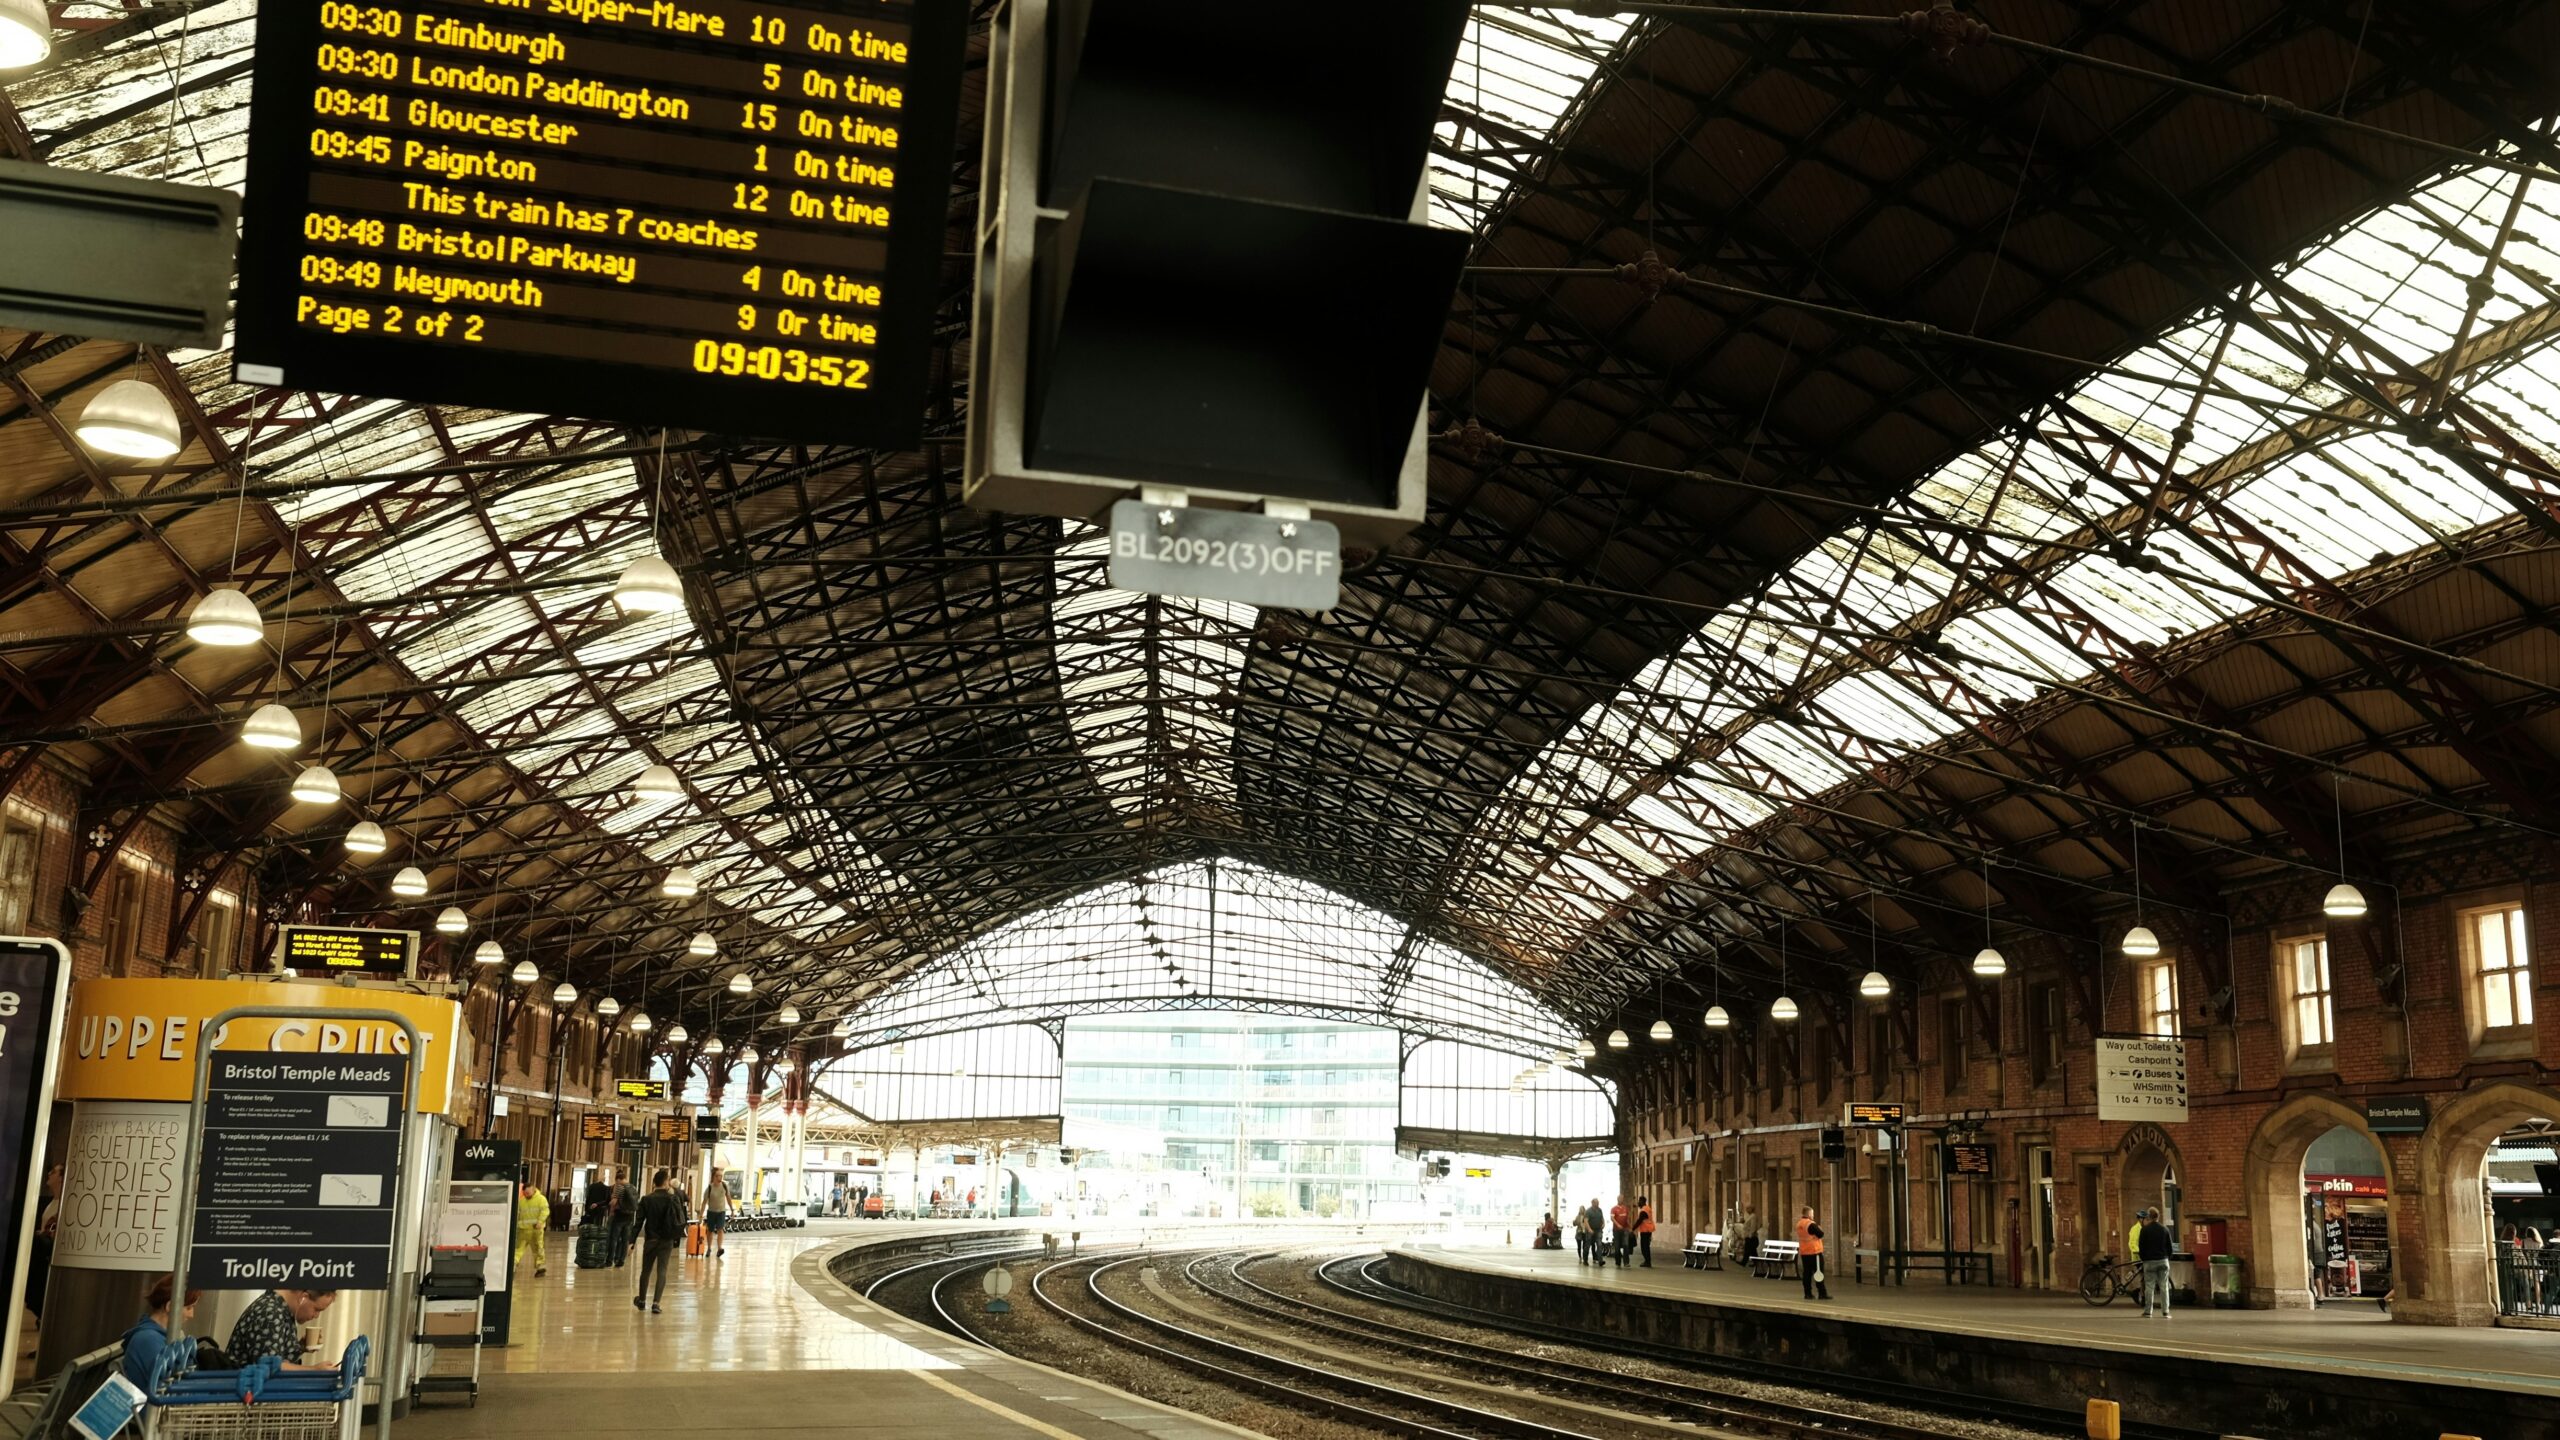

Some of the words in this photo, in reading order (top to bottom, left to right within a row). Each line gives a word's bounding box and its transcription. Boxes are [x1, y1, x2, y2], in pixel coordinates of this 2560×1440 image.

[750, 15, 786, 46] 10
[807, 23, 842, 54] On
[848, 29, 908, 64] time
[320, 1, 402, 38] 09:30
[414, 13, 566, 65] Edinburgh
[762, 63, 782, 91] 5
[802, 69, 838, 100] On
[843, 74, 903, 109] time
[317, 43, 399, 80] 09:30
[411, 56, 520, 97] London
[524, 71, 690, 121] Paddington
[741, 101, 778, 132] 15
[798, 109, 833, 140] On
[839, 114, 899, 149] time
[313, 86, 391, 123] 09:41
[408, 98, 579, 145] Gloucester
[753, 144, 768, 172] 1
[793, 149, 829, 180] On
[834, 154, 895, 188] time
[310, 128, 392, 164] 09:45
[403, 140, 537, 183] Paignton
[732, 182, 769, 213] 12
[789, 189, 825, 220] On
[830, 194, 890, 227] time
[402, 181, 467, 215] This
[472, 191, 550, 226] train
[555, 200, 610, 233] has
[615, 208, 634, 236] 7
[638, 217, 759, 251] coaches
[303, 212, 385, 247] 09:48
[397, 223, 506, 262] Bristol
[509, 236, 636, 284] Parkway
[741, 265, 762, 292] 4
[781, 269, 817, 298] On
[821, 273, 882, 306] time
[300, 254, 382, 289] 09:49
[393, 264, 543, 308] Weymouth
[737, 304, 757, 331] 9
[817, 313, 877, 345] time
[297, 295, 371, 334] Page
[383, 305, 404, 333] 2
[415, 311, 453, 338] of
[464, 314, 485, 342] 2
[692, 339, 870, 390] 09:03:52
[1115, 531, 1334, 576] BL2092(3)OFF
[2106, 1041, 2124, 1050] Way
[2144, 1042, 2171, 1051] Toilets
[2128, 1056, 2172, 1065] Cashpoint
[225, 1064, 276, 1080] Bristol
[280, 1066, 336, 1083] Temple
[340, 1067, 391, 1082] Meads
[2144, 1070, 2172, 1078] Buses
[232, 1094, 254, 1102] release
[254, 1094, 274, 1102] trolley
[2133, 1083, 2173, 1092] WHSmith
[2122, 1096, 2130, 1104] to
[2132, 1096, 2139, 1104] 4
[2146, 1096, 2151, 1104] 7
[2368, 1108, 2384, 1117] Bristol
[2385, 1108, 2403, 1118] Temple
[2404, 1107, 2420, 1116] Meads
[77, 1120, 118, 1135] RESHLY
[126, 1120, 180, 1136] BAKED
[219, 1132, 227, 1140] To
[228, 1134, 250, 1142] replace
[251, 1134, 270, 1142] trolley
[72, 1135, 177, 1161] BAGUETTES
[465, 1144, 495, 1159] GWR
[68, 1161, 173, 1193] PASTRIES
[2323, 1178, 2352, 1192] pkin
[64, 1192, 171, 1230] COFFEE
[466, 1208, 472, 1216] is
[473, 1208, 500, 1216] platform
[60, 1230, 86, 1251] AND
[95, 1232, 164, 1254] MORE
[466, 1224, 482, 1246] 3
[222, 1258, 294, 1282] Trolley
[300, 1260, 355, 1278] Point
